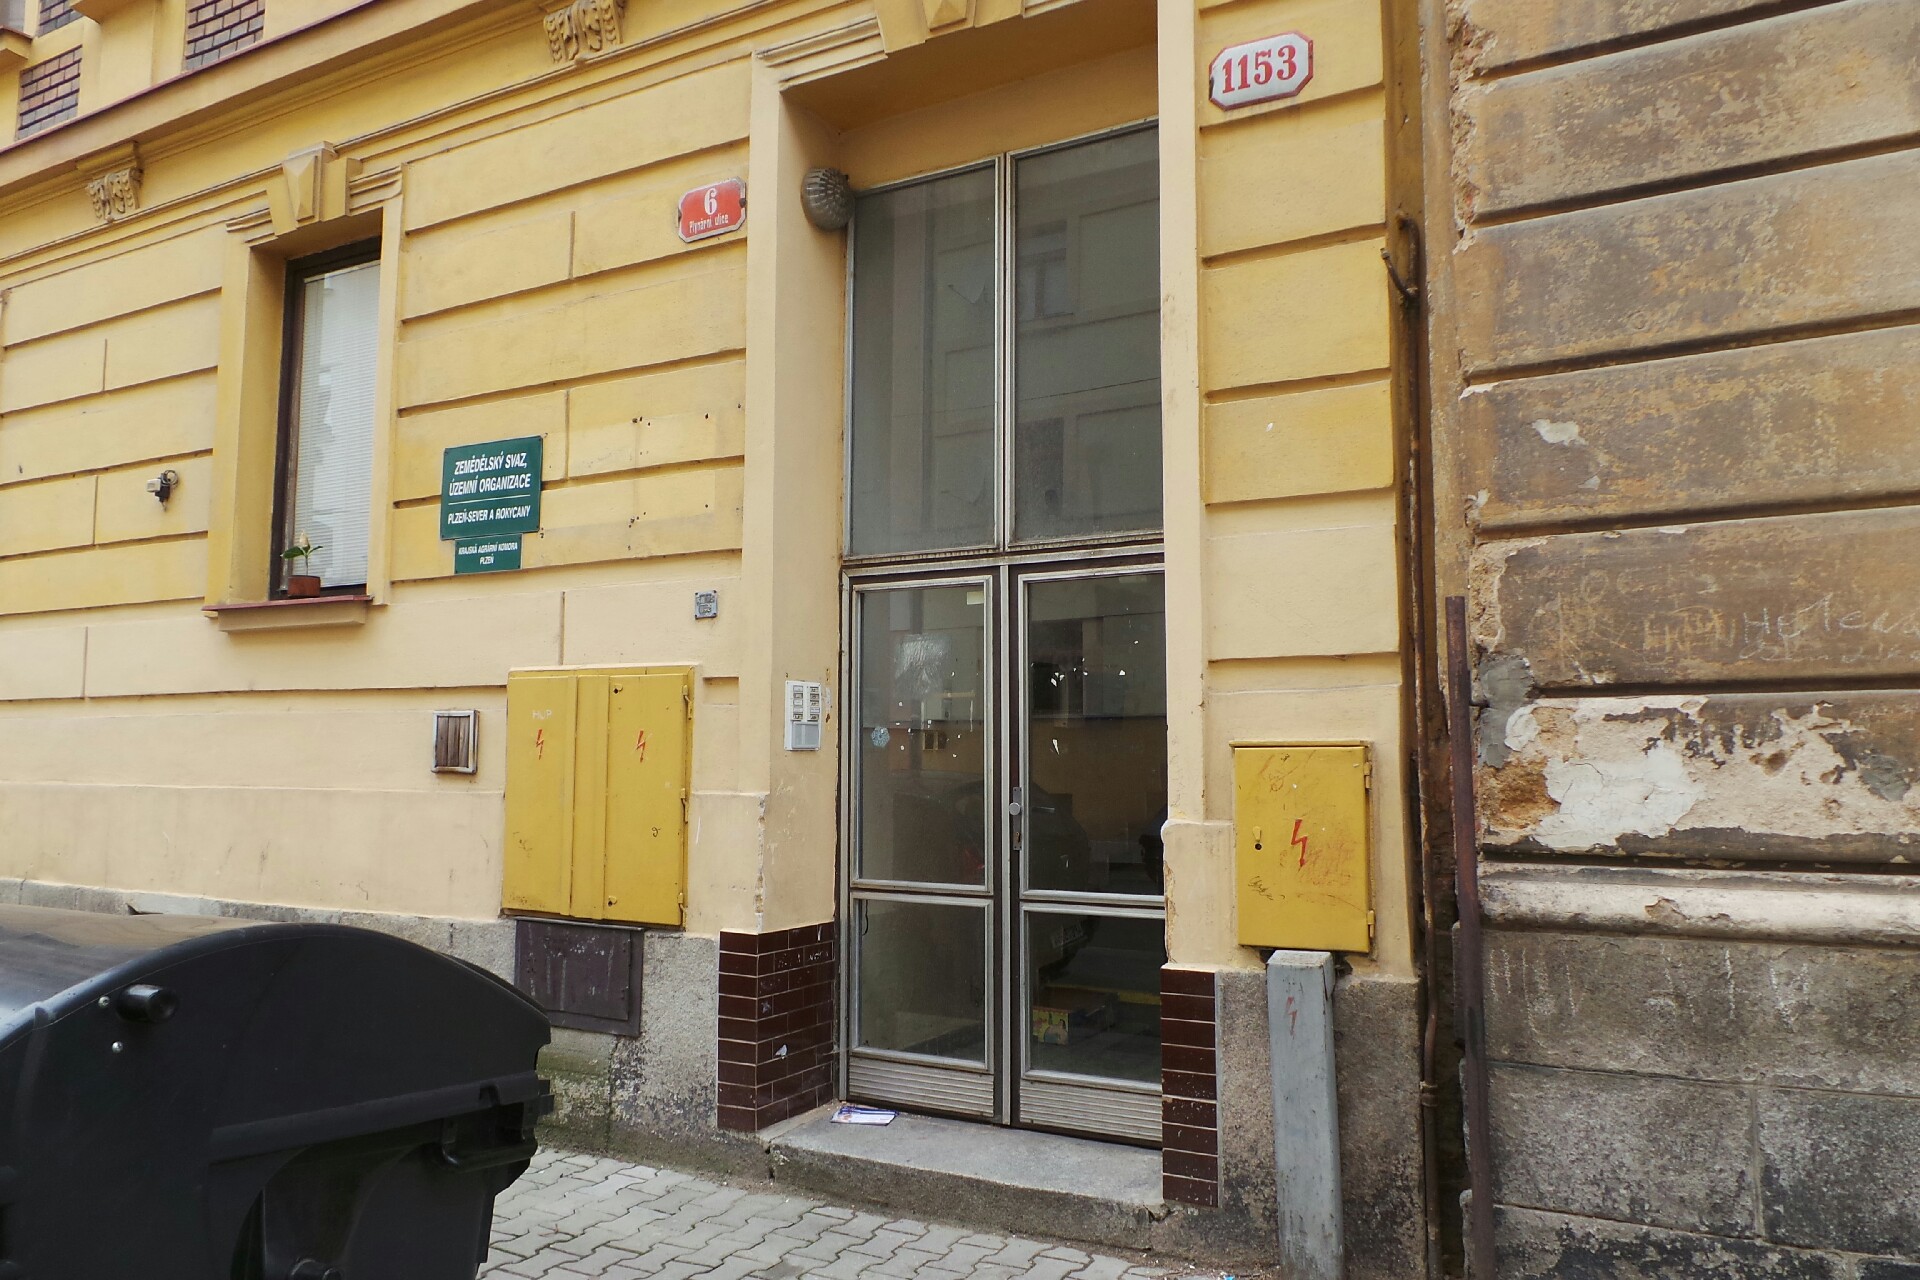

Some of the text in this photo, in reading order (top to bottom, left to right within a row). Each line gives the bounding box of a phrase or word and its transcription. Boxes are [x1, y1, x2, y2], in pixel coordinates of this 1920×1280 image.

[1222, 44, 1297, 94] 1153
[704, 188, 718, 215] 6
[714, 213, 728, 226] ulice
[454, 450, 528, 475] ZEMĚDĚLSKÝ SVAZ,
[449, 473, 531, 496] ÚZEMNÍ ORGANIZACE
[448, 505, 531, 525] PLZEŇ-SEVER A ROKYCANY
[498, 541, 518, 552] KOMORA
[479, 553, 494, 565] PLZEŇ
